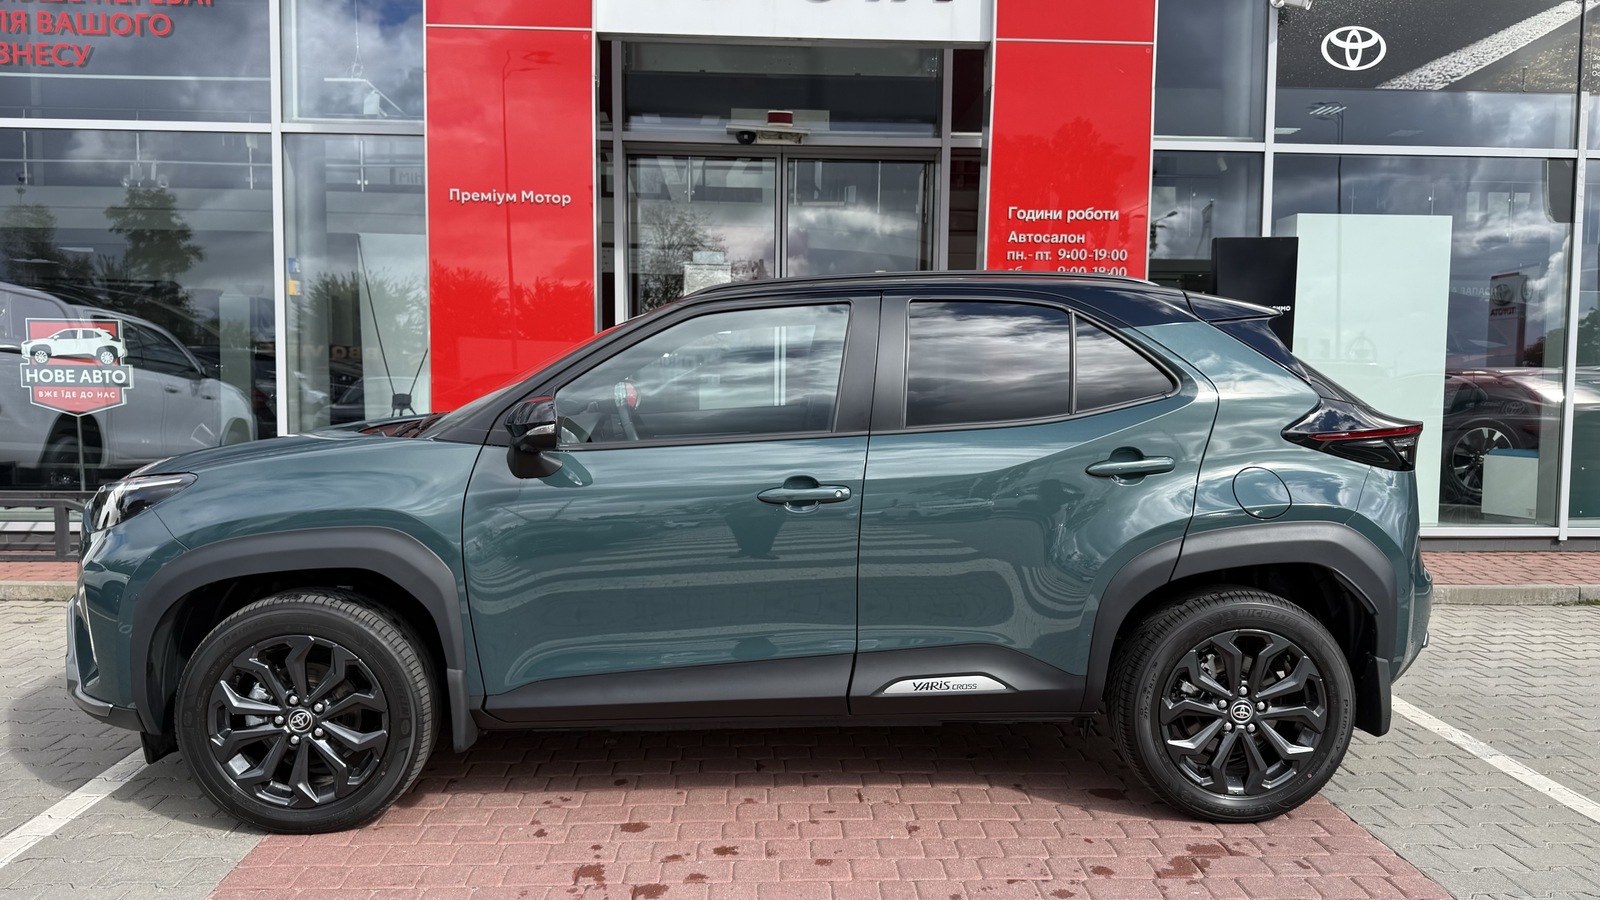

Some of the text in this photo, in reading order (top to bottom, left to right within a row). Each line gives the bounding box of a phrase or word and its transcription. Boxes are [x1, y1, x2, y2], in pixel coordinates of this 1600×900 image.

[37, 12, 171, 36] ВАШОГО
[449, 188, 571, 206] Преміум Мотор
[1008, 206, 1119, 223] Години роботи
[1008, 231, 1085, 243] Автосалон
[26, 369, 126, 384] НОВЕ АВТО
